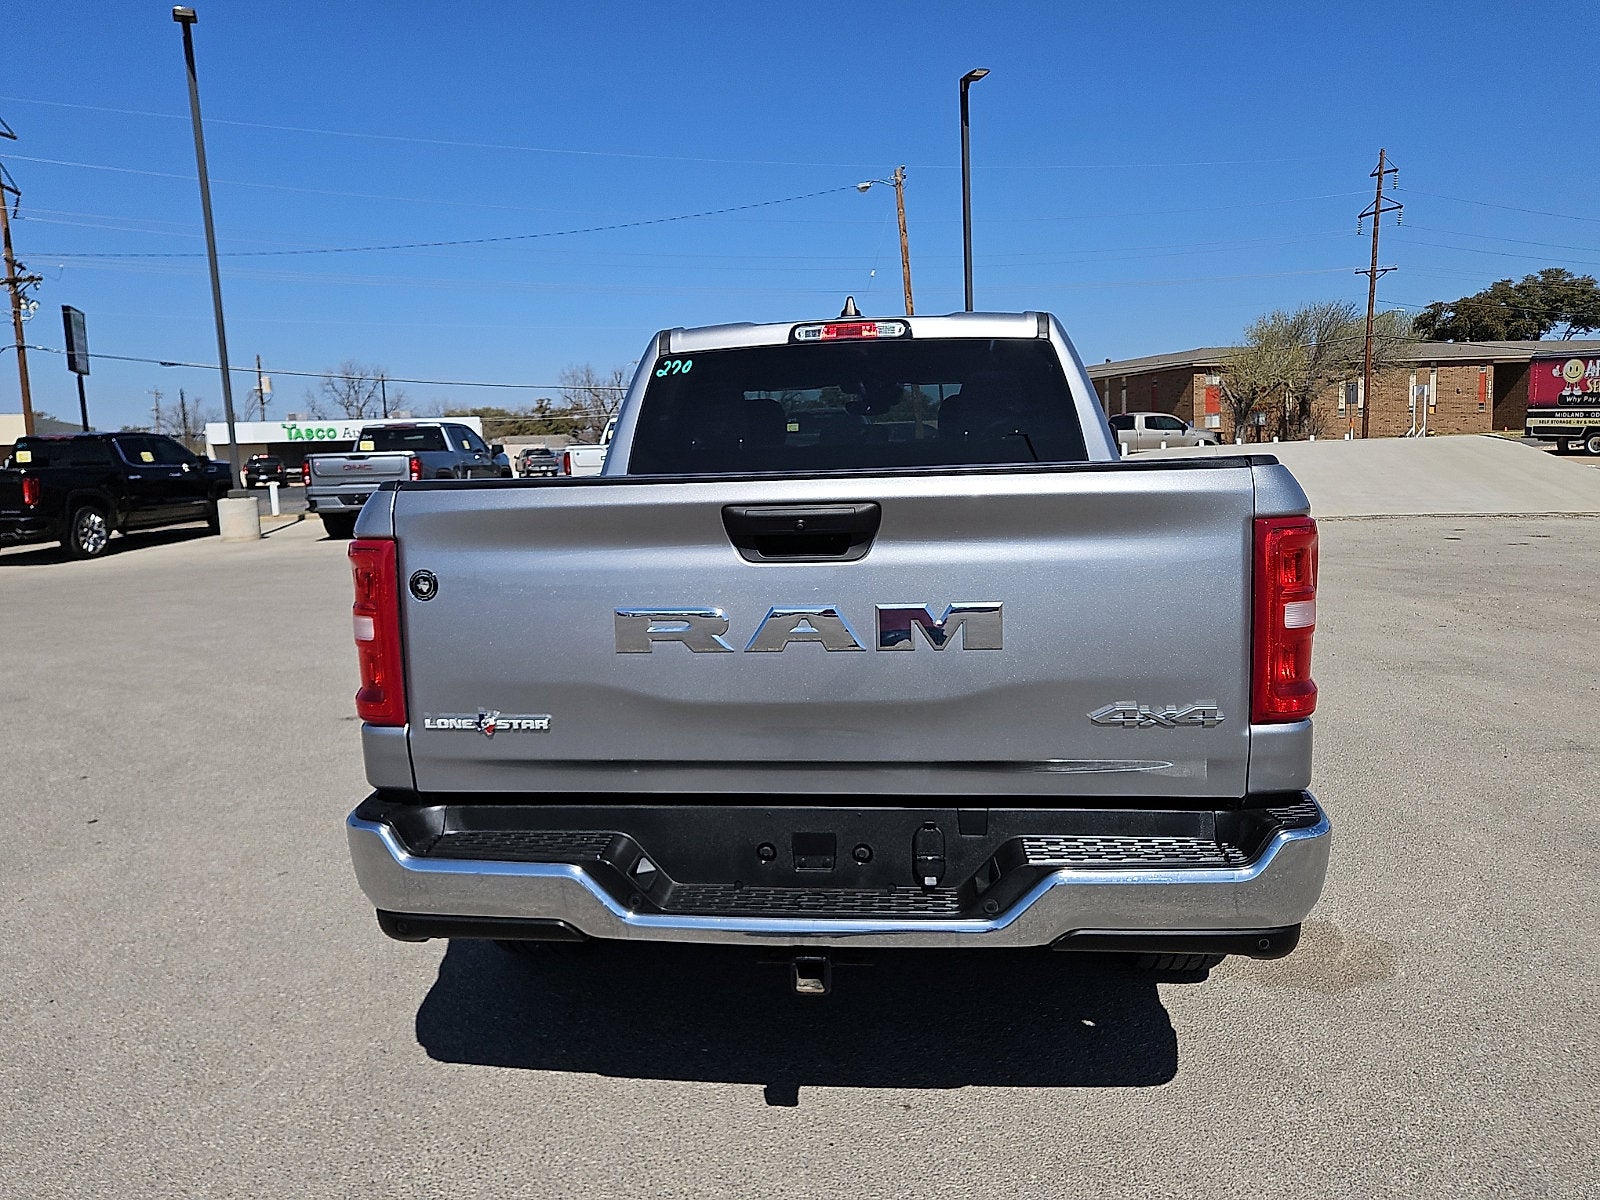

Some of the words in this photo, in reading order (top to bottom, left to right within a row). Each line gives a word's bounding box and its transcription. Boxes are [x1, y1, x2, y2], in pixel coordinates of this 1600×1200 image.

[656, 359, 693, 378] 270
[281, 424, 337, 440] TASCO
[614, 601, 1005, 654] RAM
[424, 717, 476, 730] LONE
[496, 717, 551, 730] STAR
